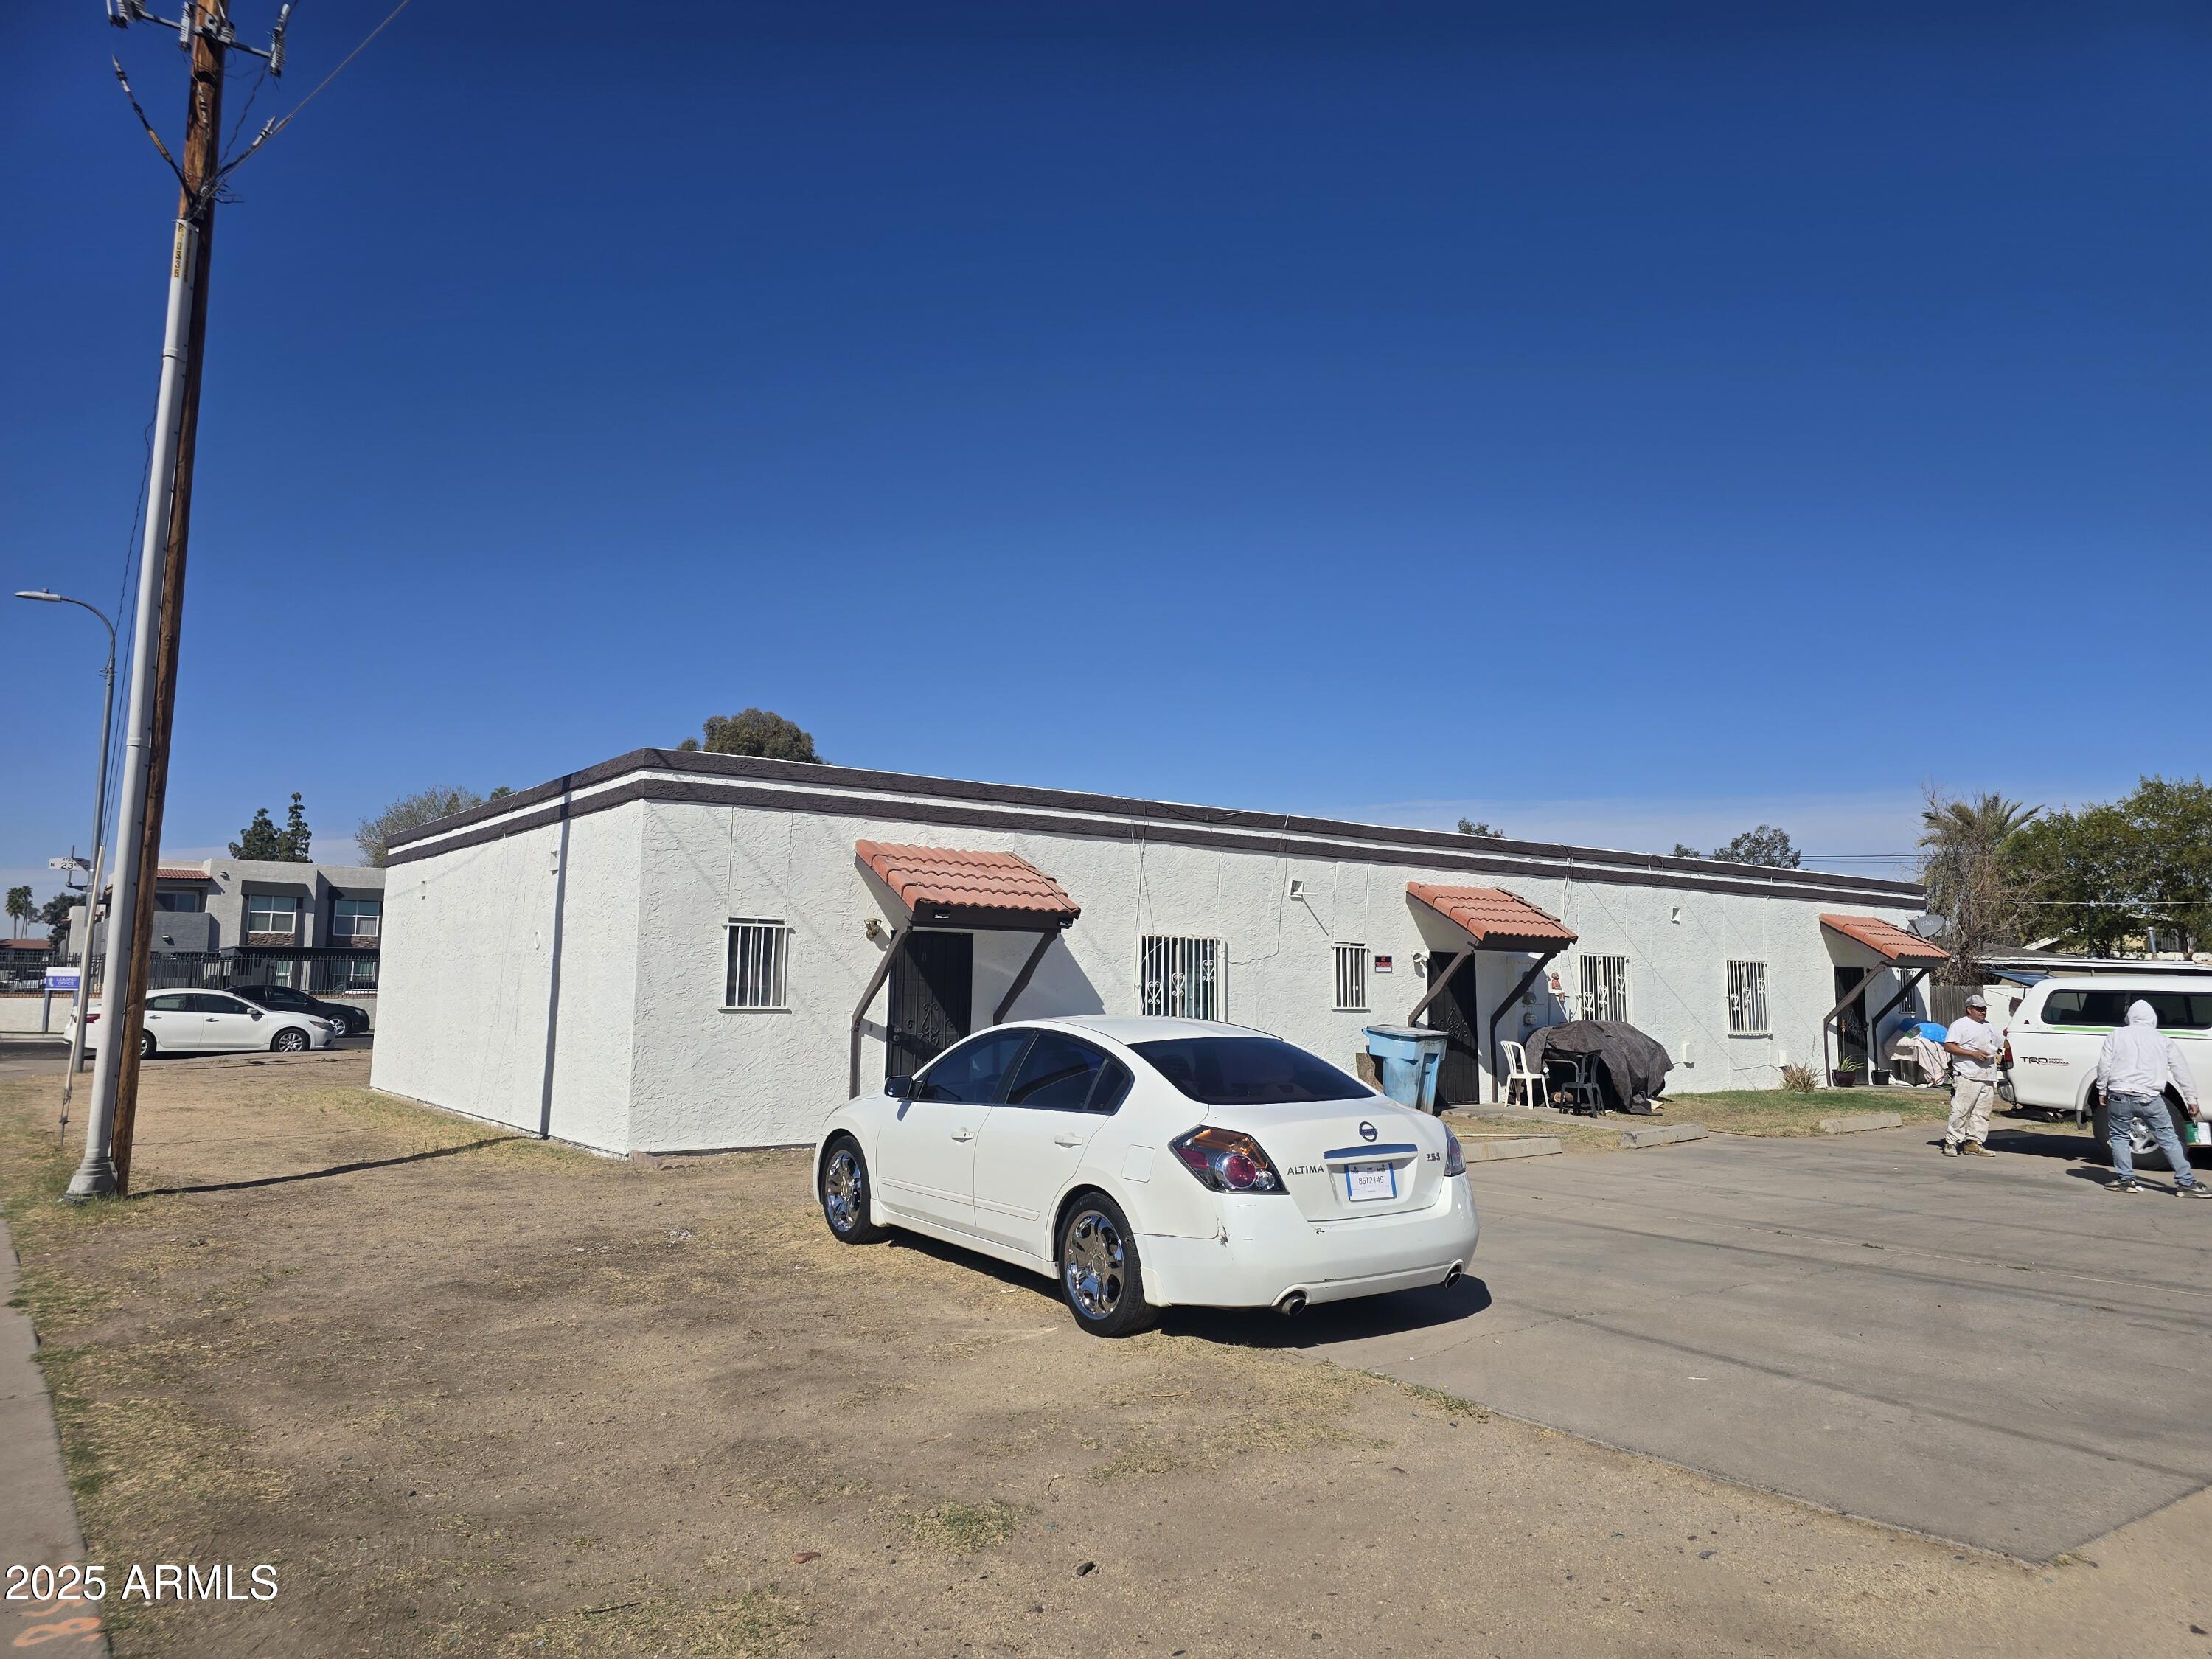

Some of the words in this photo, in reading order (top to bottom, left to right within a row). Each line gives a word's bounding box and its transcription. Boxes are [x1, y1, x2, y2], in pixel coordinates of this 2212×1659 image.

[2020, 1056, 2048, 1065] TRD
[1287, 1165, 1324, 1175] ALTIMA
[1358, 1175, 1384, 1186] 86T2149
